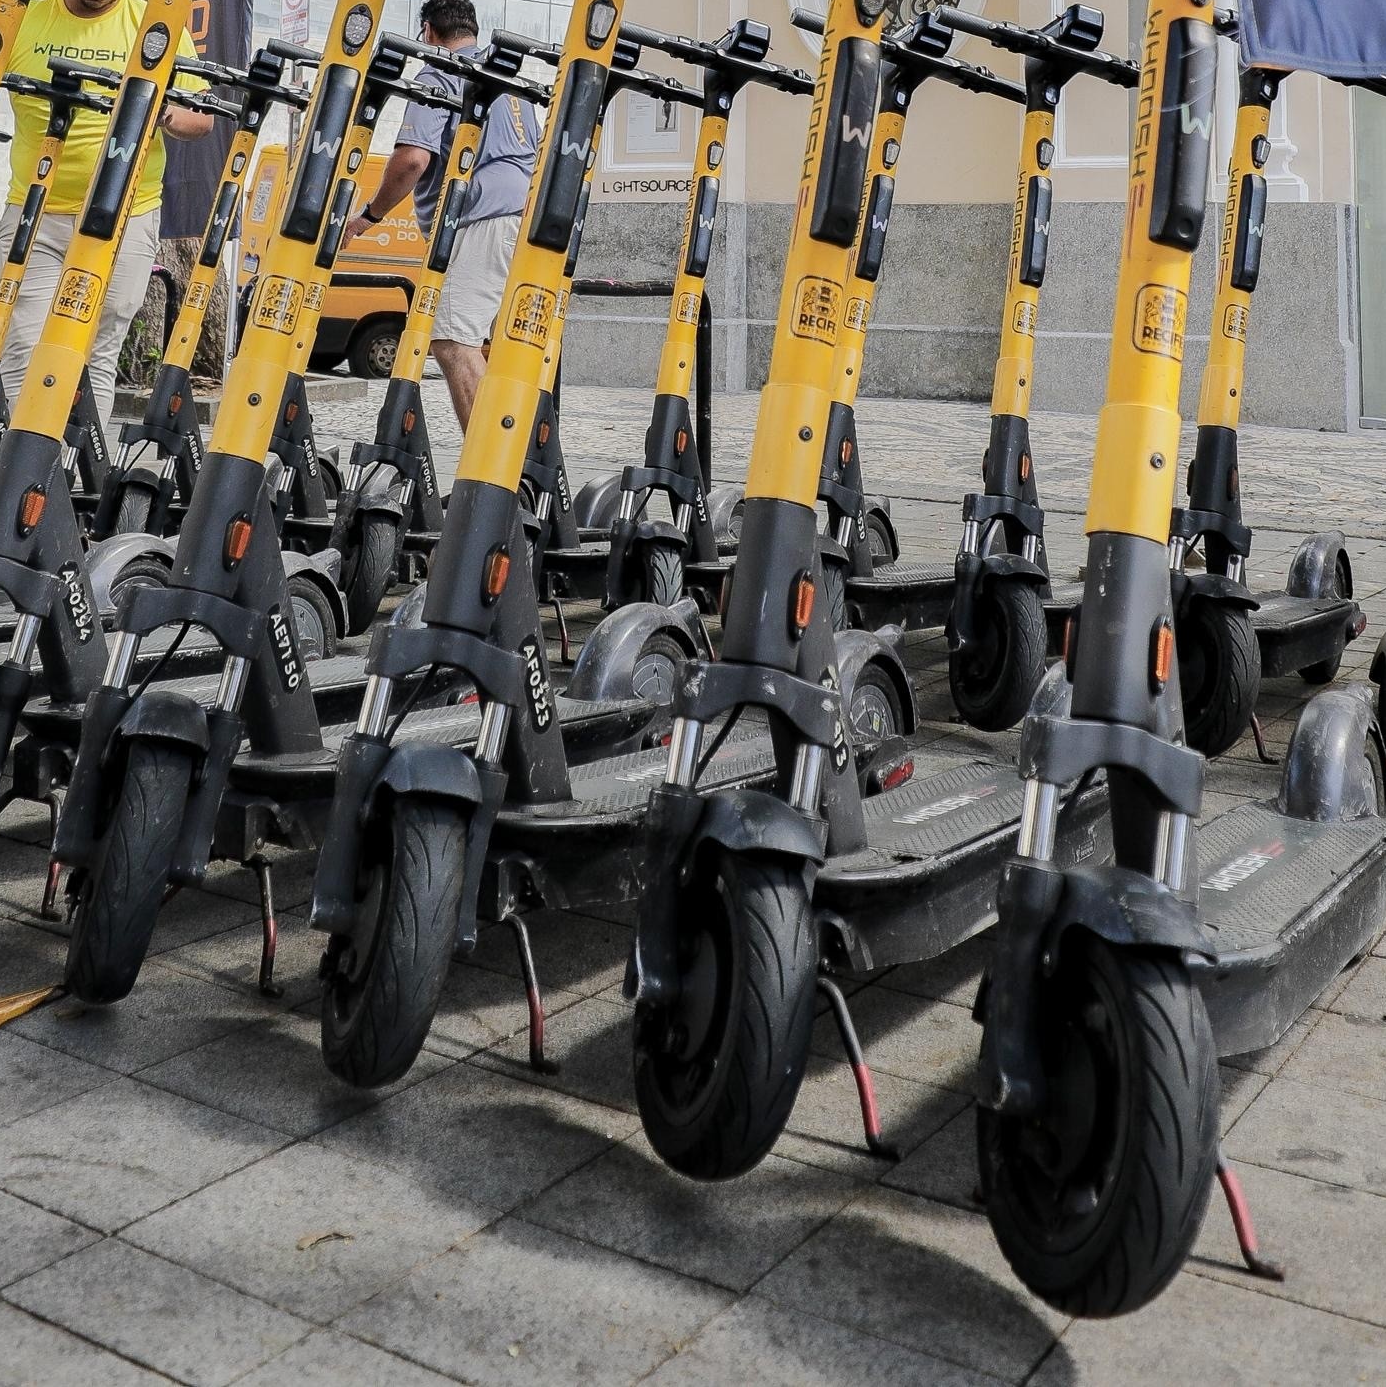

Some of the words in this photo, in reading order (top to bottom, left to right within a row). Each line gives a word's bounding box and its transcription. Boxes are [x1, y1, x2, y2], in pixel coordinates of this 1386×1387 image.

[34, 43, 126, 63] WHOOSH
[801, 28, 835, 181] WHOOSH
[1131, 9, 1163, 181] WHOOSH
[312, 130, 341, 158] W
[561, 130, 591, 161] W
[842, 114, 872, 149] W
[107, 137, 137, 163] W
[1011, 170, 1027, 254] WHOOSH
[1222, 168, 1239, 256] WHOOSH
[397, 231, 418, 242] DO
[58, 296, 91, 315] RECIFE
[259, 306, 294, 326] RECIFE
[847, 316, 866, 327] RECIF
[1016, 320, 1036, 334] RECIF
[1228, 325, 1247, 336] RECIF
[270, 613, 299, 688] AE7150
[523, 645, 550, 727] AF0323
